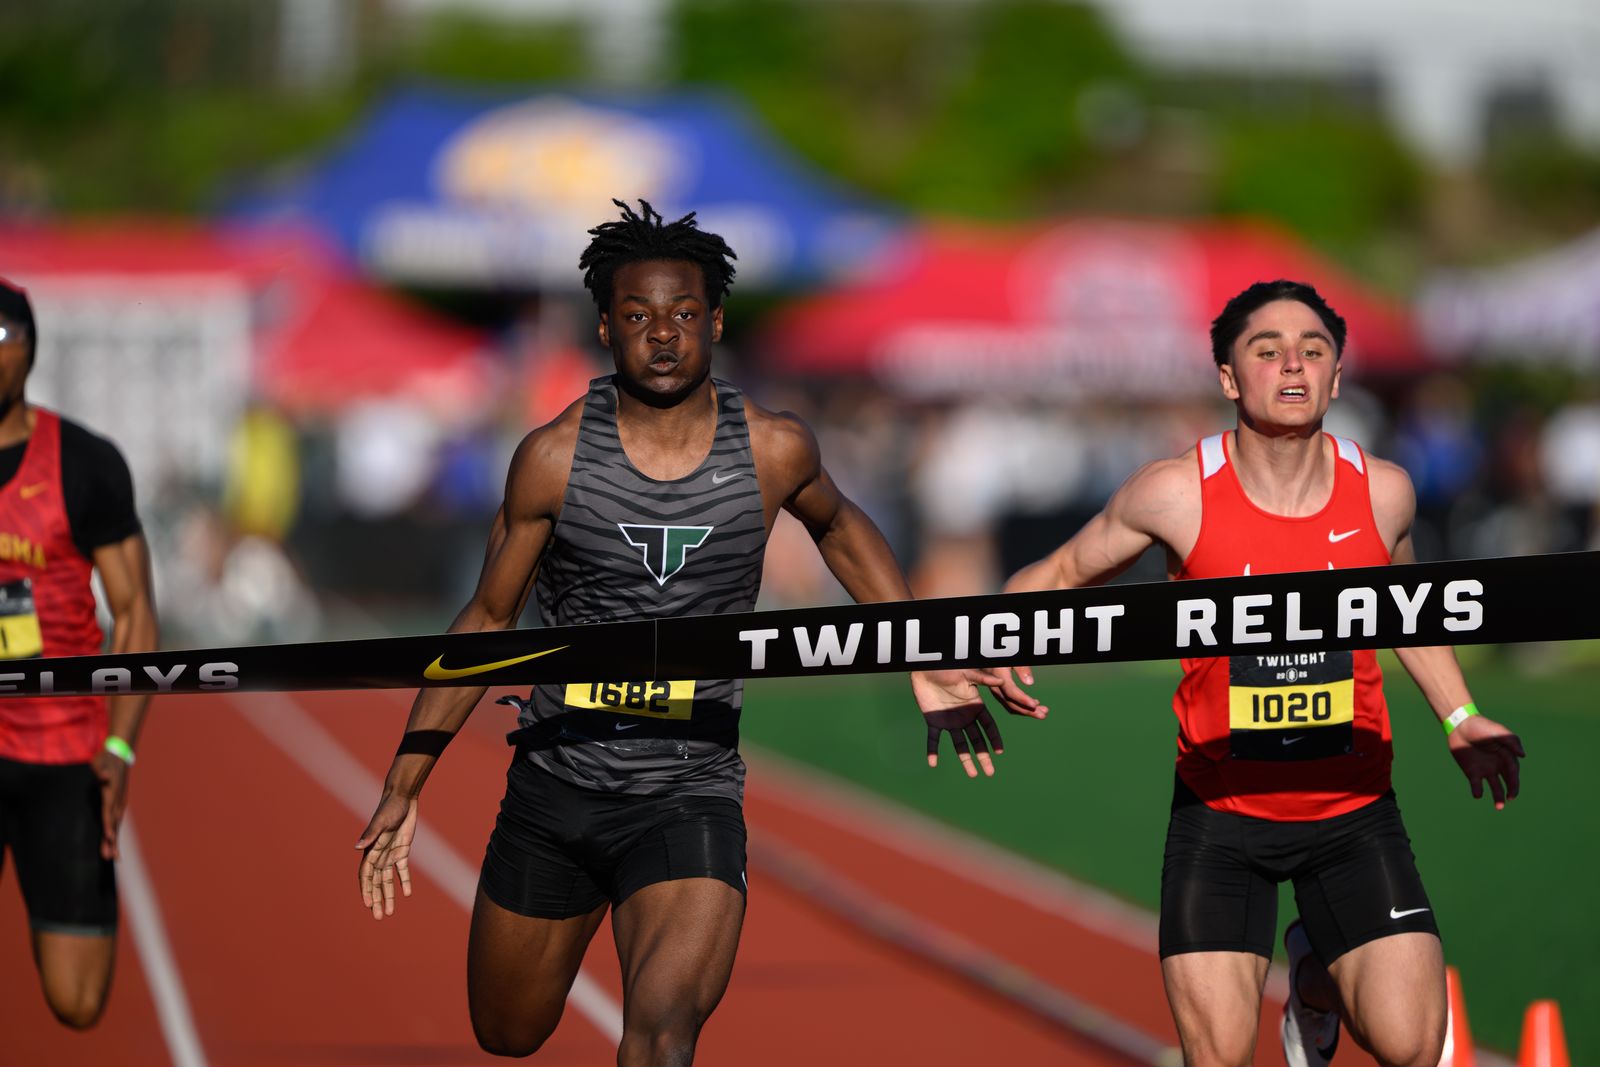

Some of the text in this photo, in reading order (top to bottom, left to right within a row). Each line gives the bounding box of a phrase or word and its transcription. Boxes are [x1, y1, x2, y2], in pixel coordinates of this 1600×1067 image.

[738, 579, 1484, 670] TWILIGHT RELAYS
[1256, 651, 1327, 667] TWILIGHT
[589, 681, 671, 713] 1682
[1252, 690, 1331, 723] 1020
